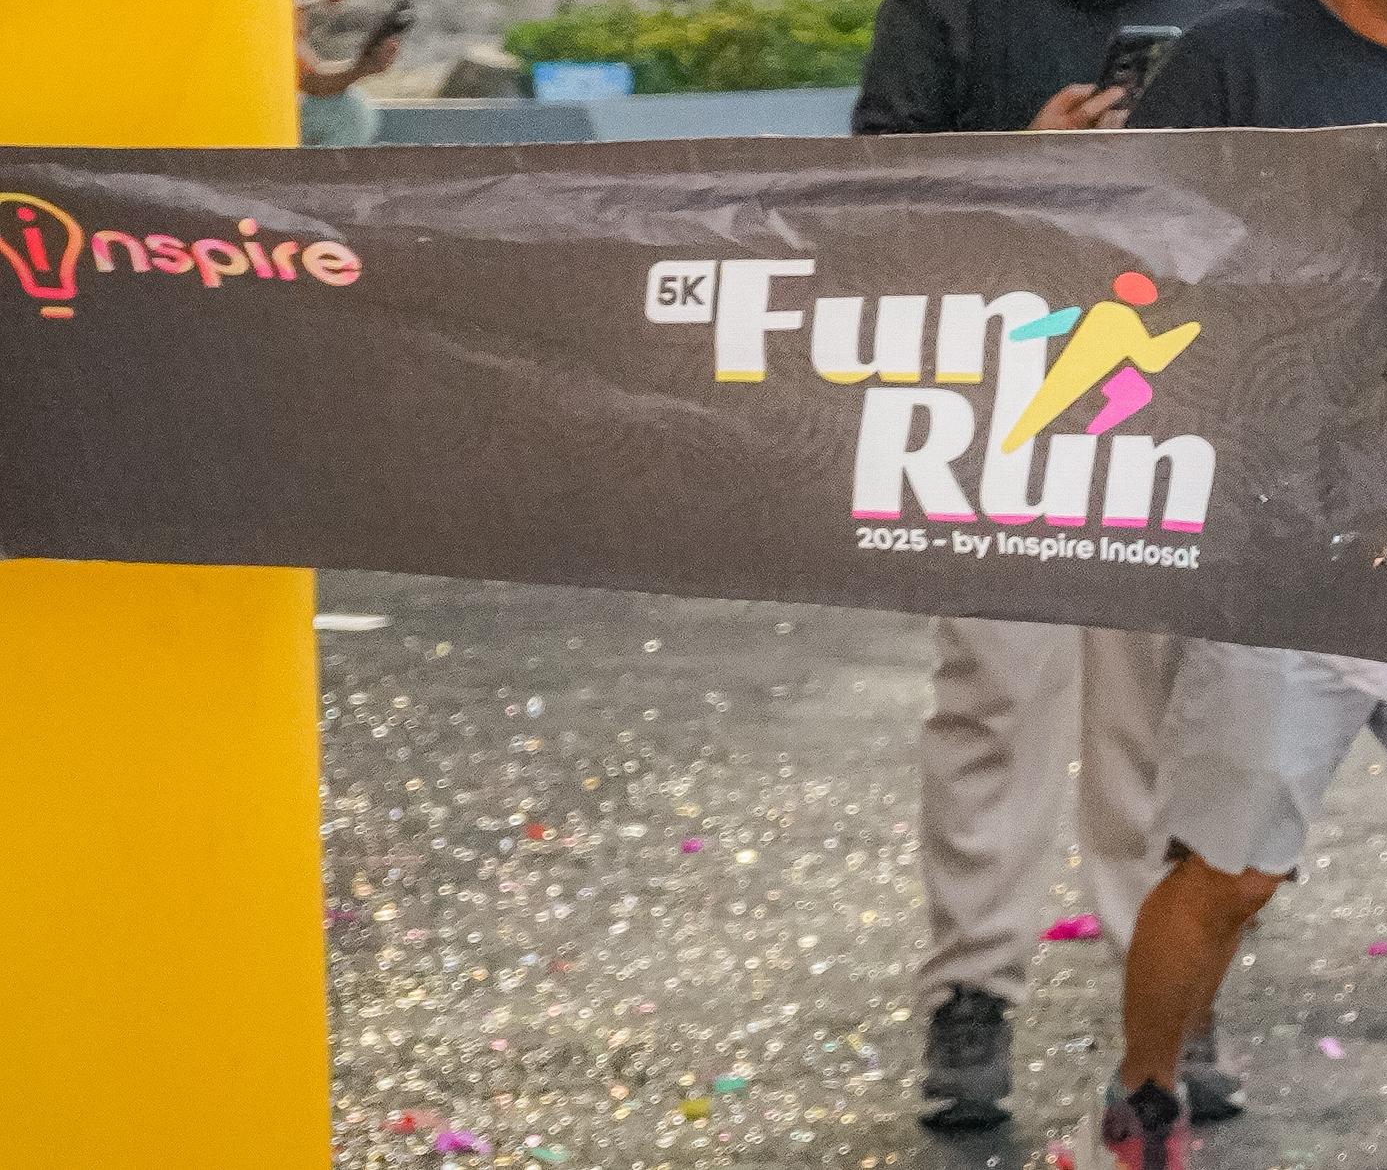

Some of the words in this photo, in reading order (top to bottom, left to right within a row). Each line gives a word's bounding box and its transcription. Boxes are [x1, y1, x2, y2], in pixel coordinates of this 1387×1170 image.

[714, 258, 1050, 385] Fun
[850, 386, 1218, 534] Run
[854, 526, 928, 553] 2025
[951, 530, 993, 560] by
[996, 532, 1096, 562] Inspire
[1100, 536, 1201, 570] Indosat
